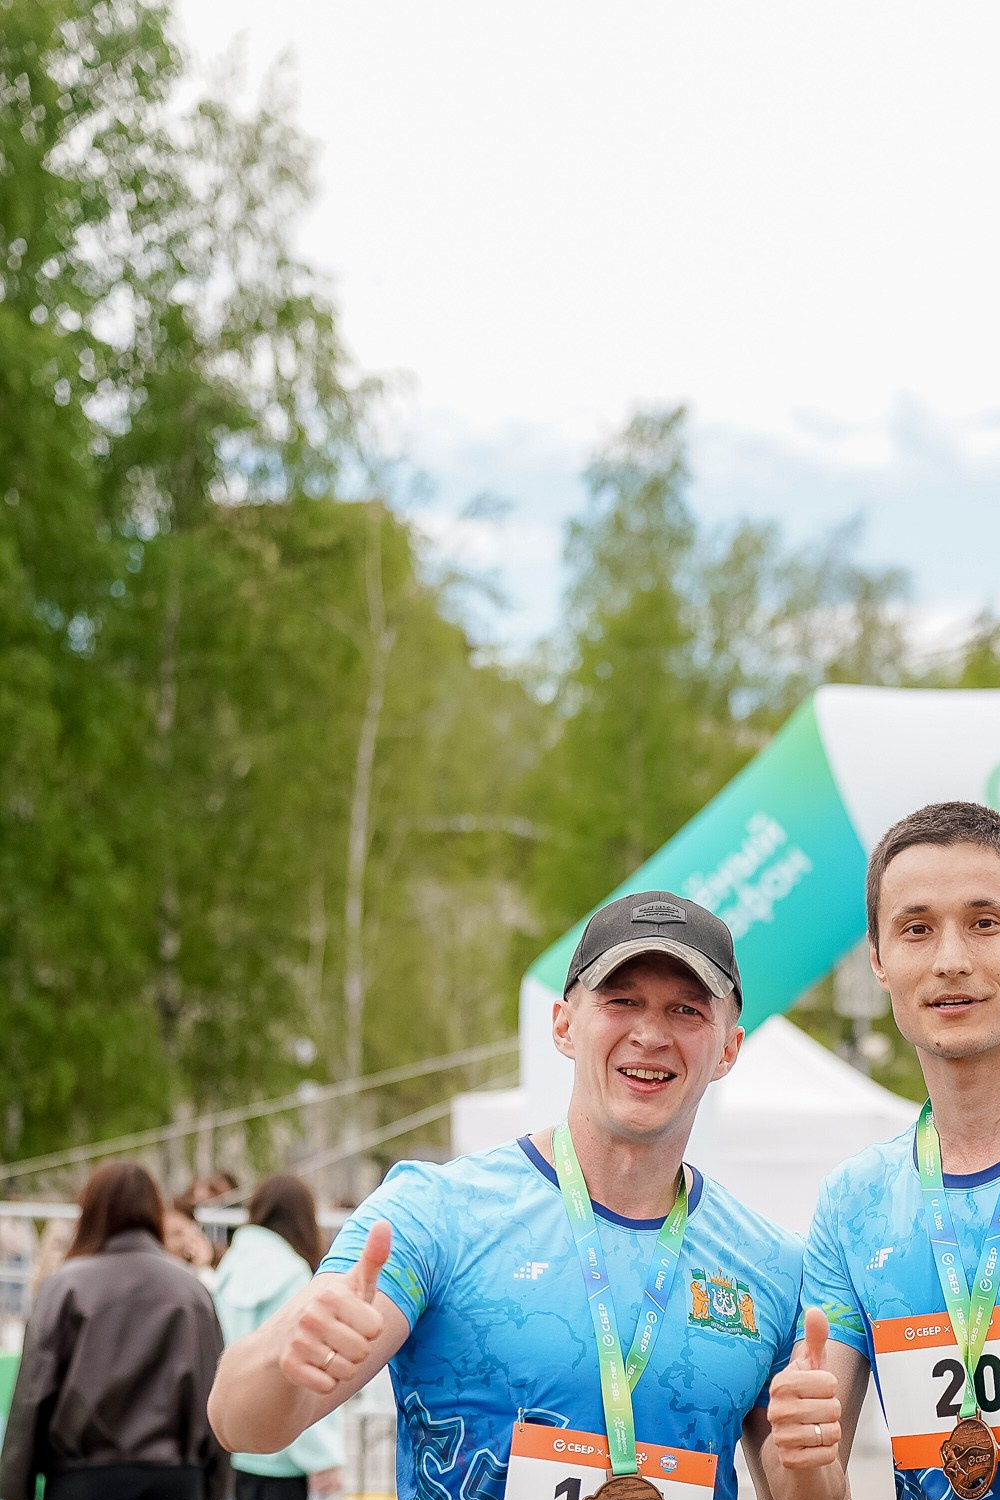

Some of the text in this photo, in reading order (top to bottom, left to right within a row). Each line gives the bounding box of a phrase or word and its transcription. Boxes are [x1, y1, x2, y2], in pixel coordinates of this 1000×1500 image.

[985, 1247, 999, 1277] СБЕР
[946, 1267, 960, 1295] СБЕР
[598, 1303, 610, 1332] СБЕР
[916, 1326, 942, 1337] СБЕР
[640, 1325, 653, 1353] СБЕР
[567, 1442, 594, 1455] СБЕР
